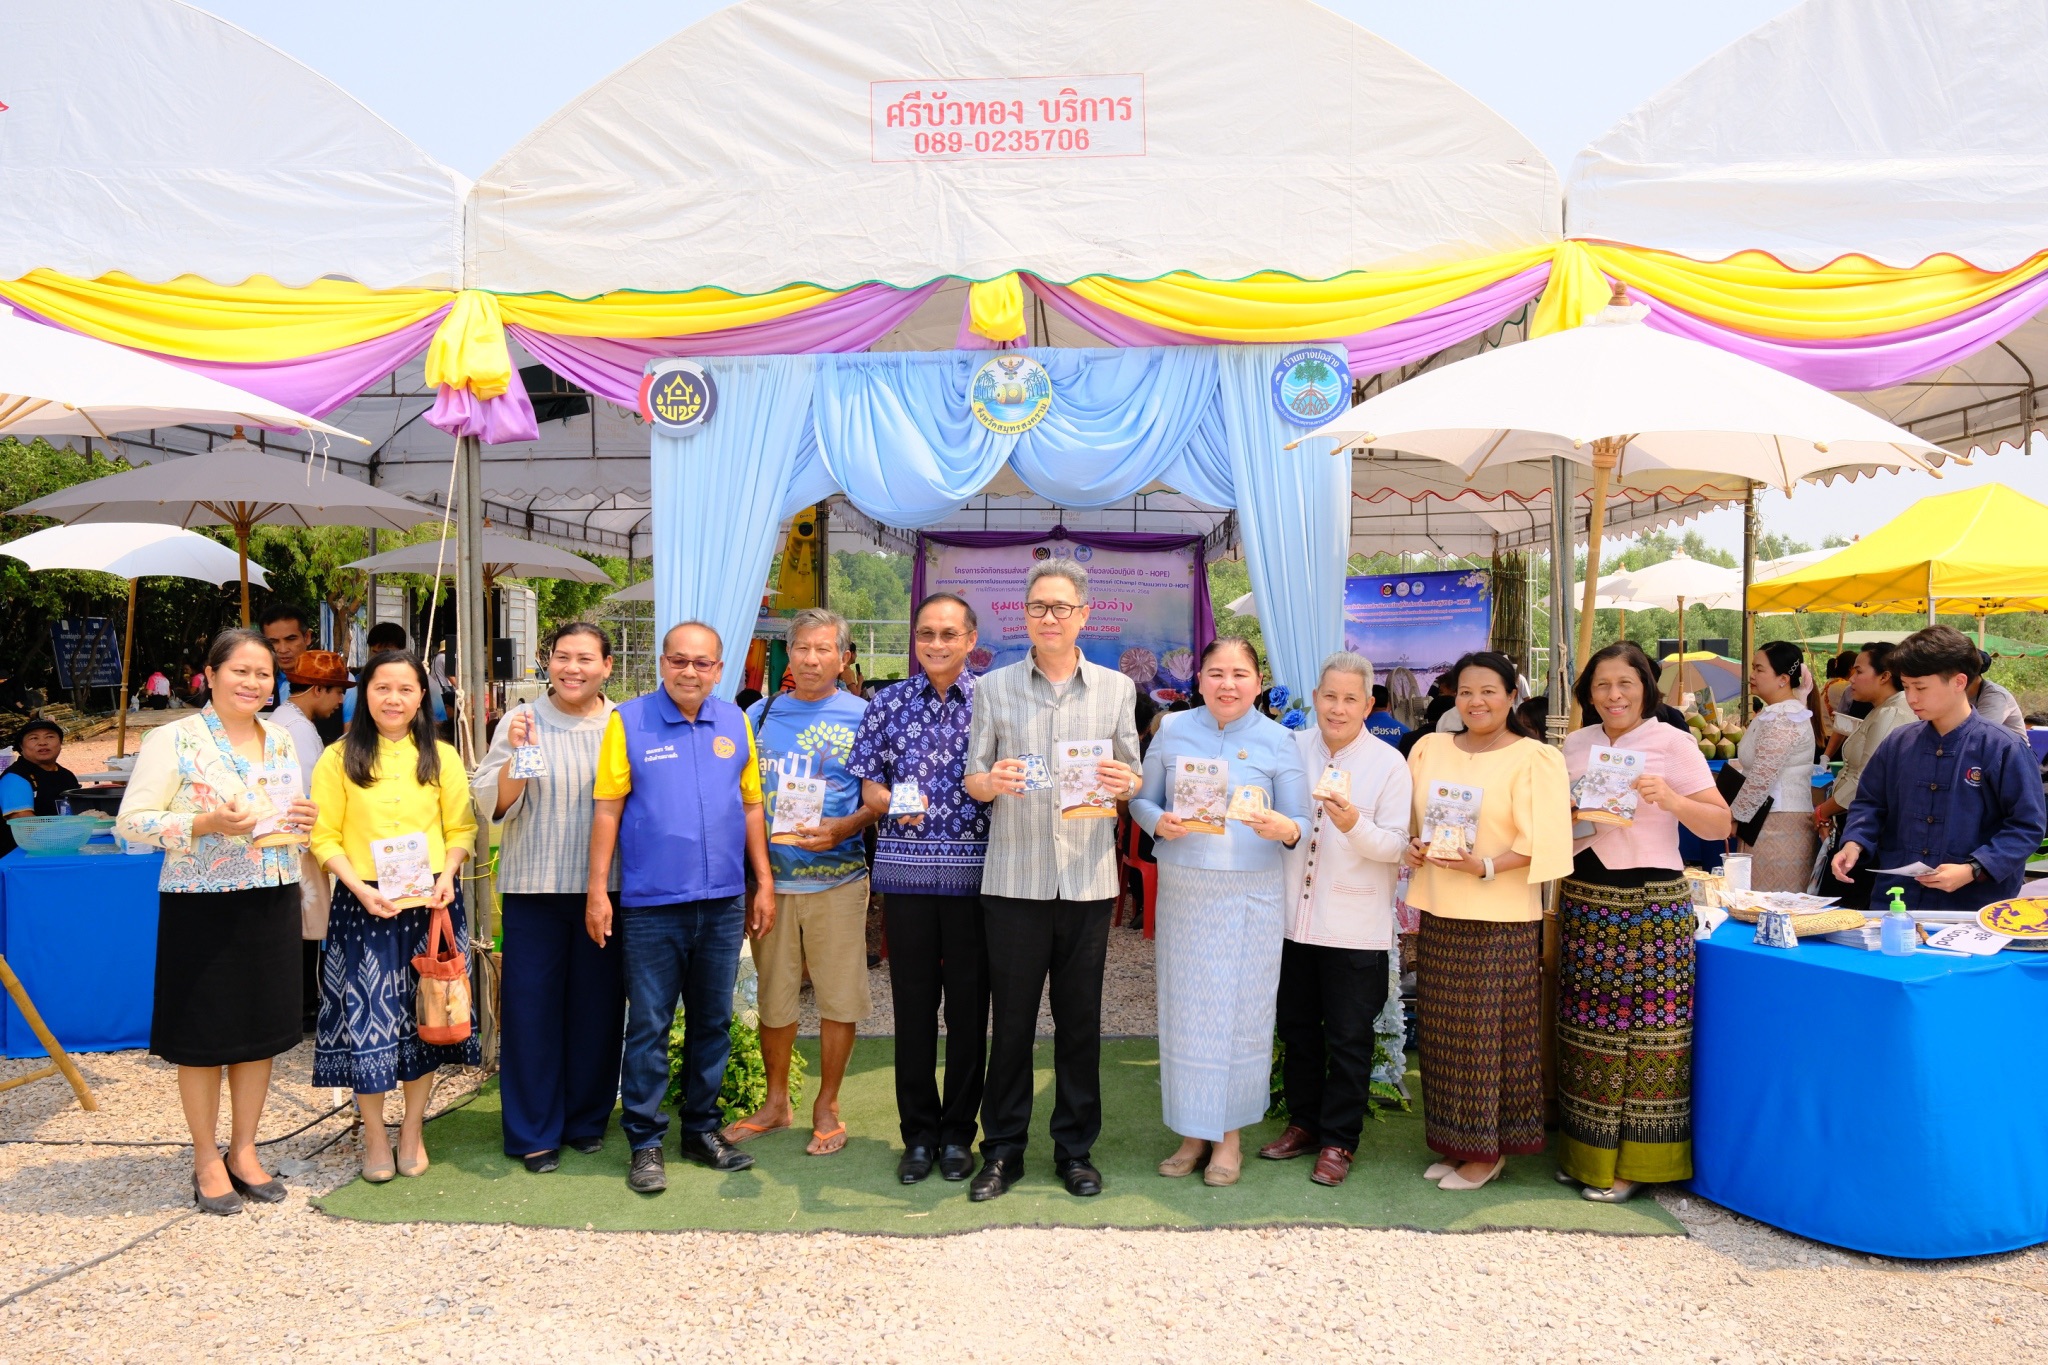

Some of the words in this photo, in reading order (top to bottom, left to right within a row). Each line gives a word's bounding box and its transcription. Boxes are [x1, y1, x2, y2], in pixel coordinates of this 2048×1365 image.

[886, 90, 1024, 128] ศรีบัวทอง
[1038, 87, 1133, 123] บริการ
[914, 128, 1090, 154] 089-0235706
[1283, 350, 1340, 368] บ้านบางบ่อล่าง
[976, 403, 1048, 434] จังหวัดสมุทรสงคราม
[1086, 565, 1136, 576] เที่ยวลงมือปฏิบัติ
